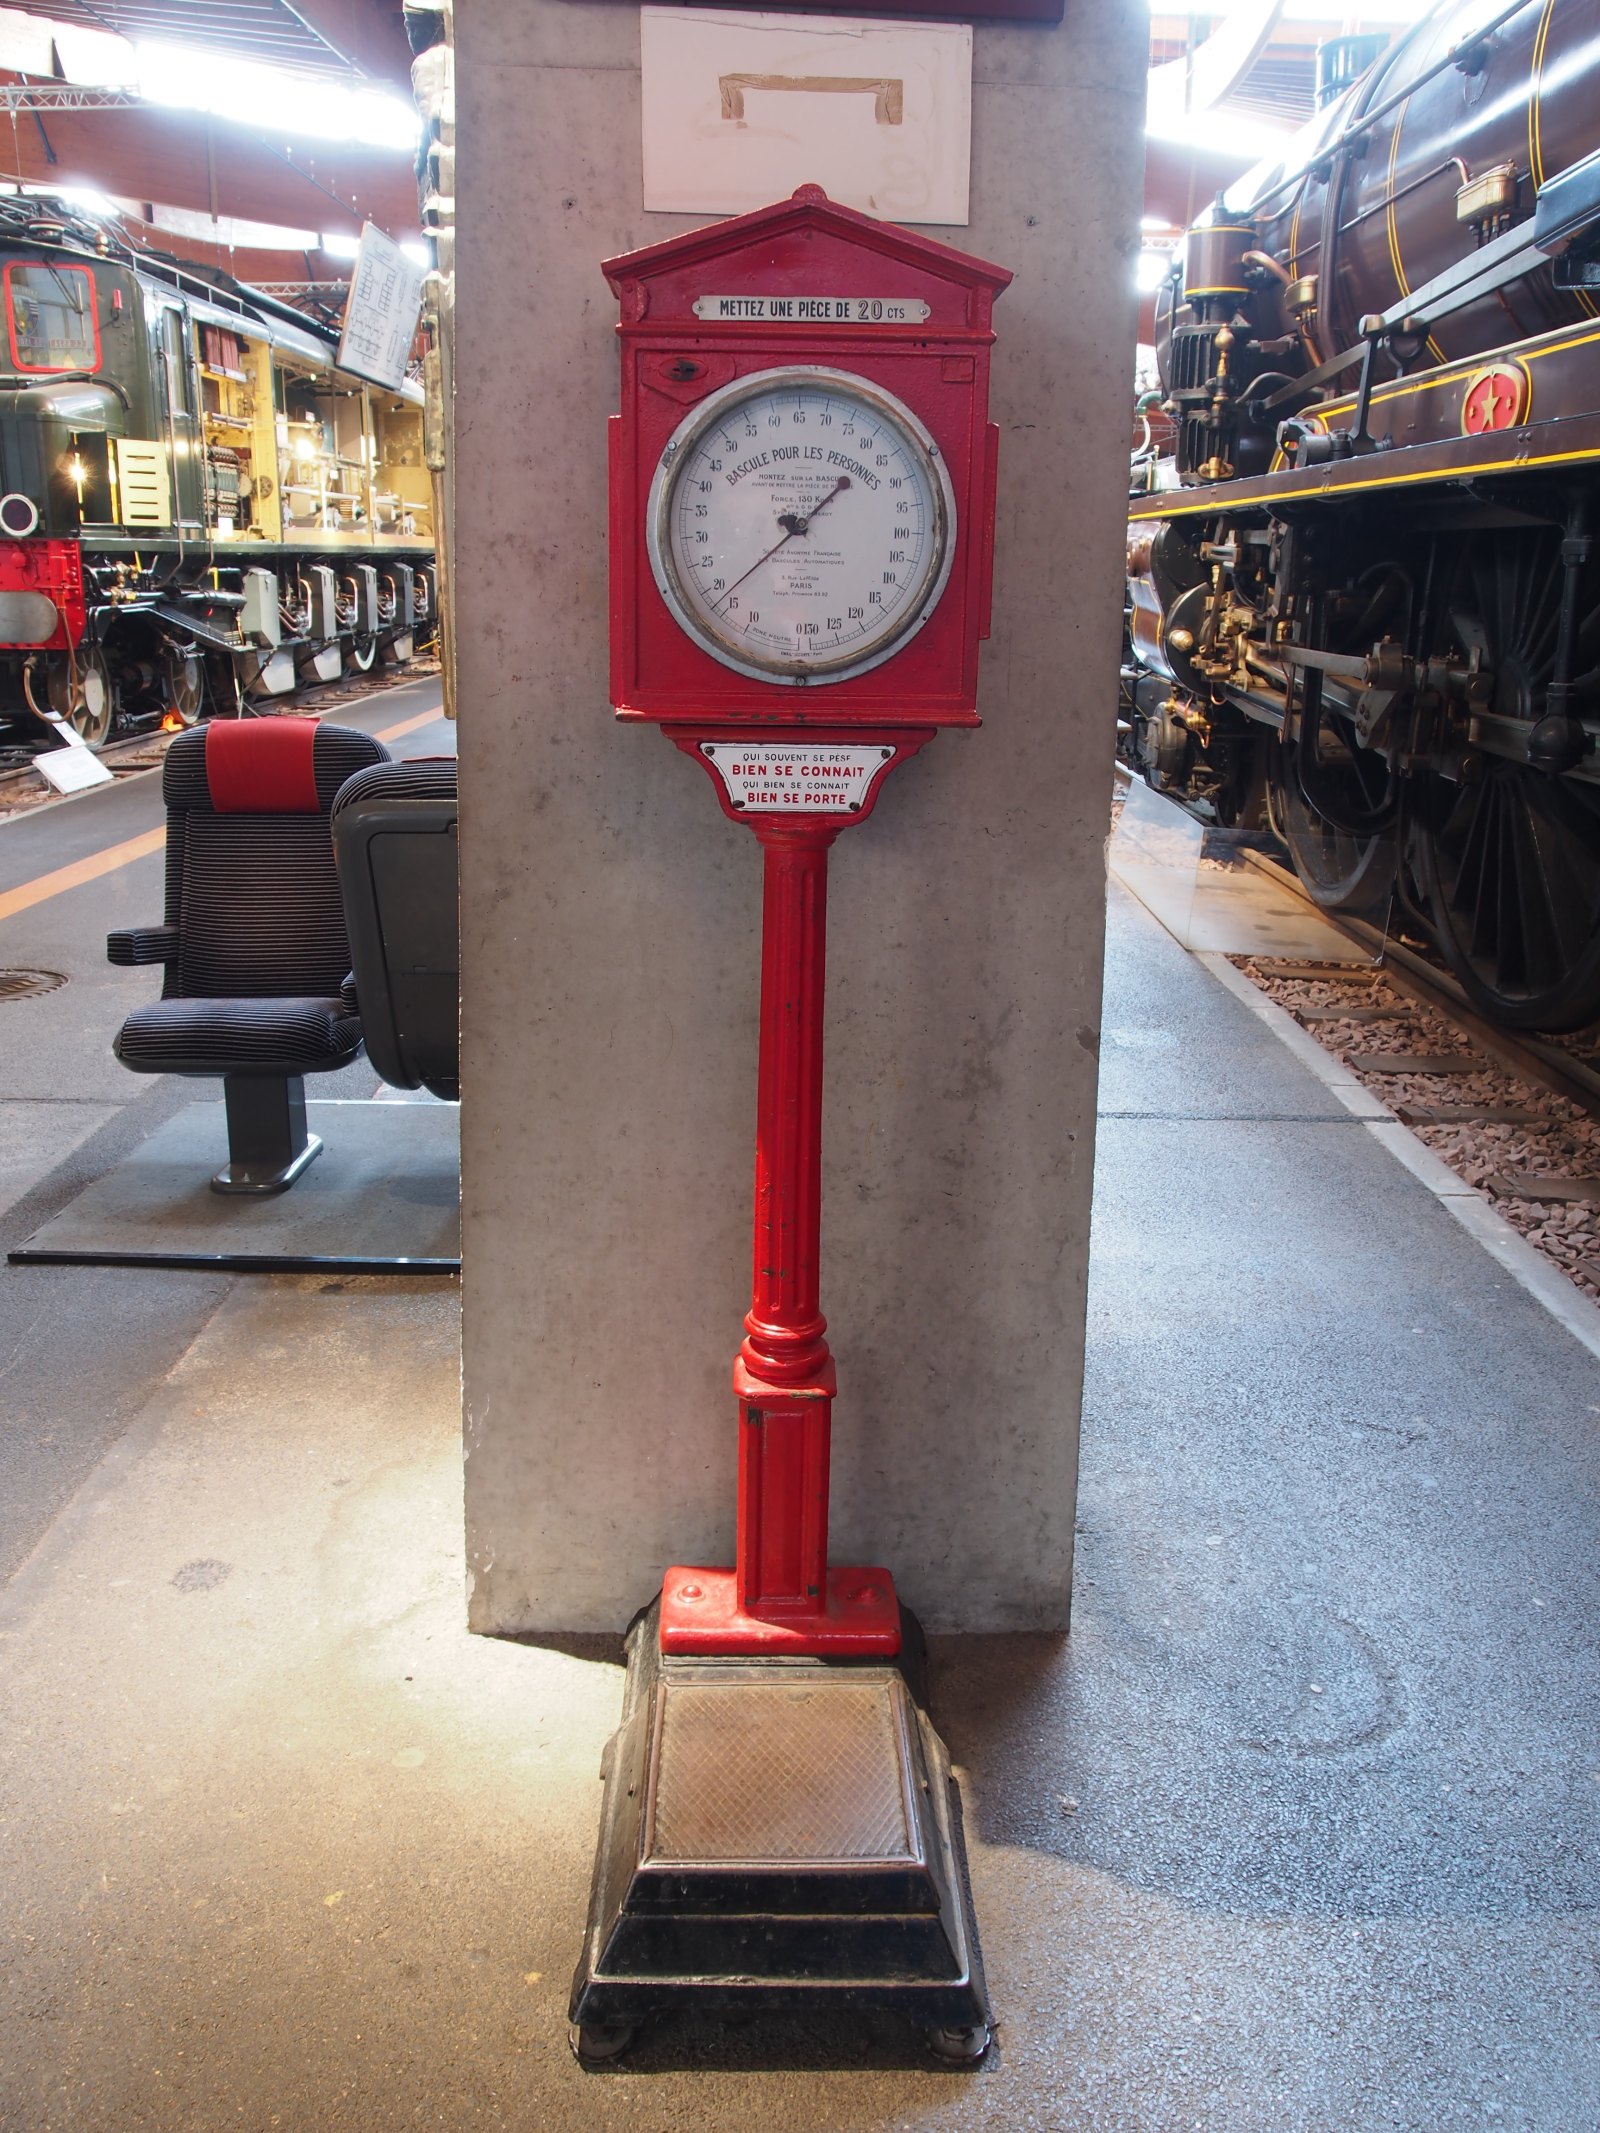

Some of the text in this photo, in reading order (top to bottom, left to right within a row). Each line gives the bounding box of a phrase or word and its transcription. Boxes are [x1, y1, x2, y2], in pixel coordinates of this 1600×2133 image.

[720, 299, 905, 320] METTEZ UNE PIÈCE DE 20 CTS
[768, 415, 781, 428] 60
[793, 411, 806, 424] 65
[819, 414, 832, 427] 70
[745, 425, 758, 438] 55
[842, 423, 855, 436] 75
[725, 440, 738, 453] 50
[859, 437, 873, 450] 80
[709, 459, 722, 472] 45
[876, 454, 889, 467] 85
[725, 446, 882, 491] BASCULE POUR LES PERSONNES
[699, 480, 713, 494] 40
[889, 477, 902, 490] 90
[695, 505, 708, 518] 35
[896, 501, 909, 514] 95
[695, 531, 708, 543] 30
[893, 527, 910, 539] 100
[701, 556, 714, 568] 25
[889, 551, 905, 563] 105
[713, 578, 725, 591] 20
[883, 572, 896, 584] 110
[729, 597, 739, 609] 15
[869, 591, 882, 604] 115
[749, 611, 760, 623] 10
[847, 607, 864, 619] 120
[796, 623, 802, 635] 0
[804, 623, 819, 635] 130
[827, 617, 842, 630] 125
[752, 626, 792, 642] ZONE NEUTRE
[743, 753, 760, 762] QUI
[765, 753, 808, 762] SOUVENT
[813, 754, 825, 762] SE
[732, 764, 864, 778] BIEN SE CONNAIT
[742, 780, 759, 789] QUI
[764, 781, 785, 789] BIEN
[807, 782, 850, 790] CONNAIT
[748, 792, 846, 804] BIEN SE PORTE
